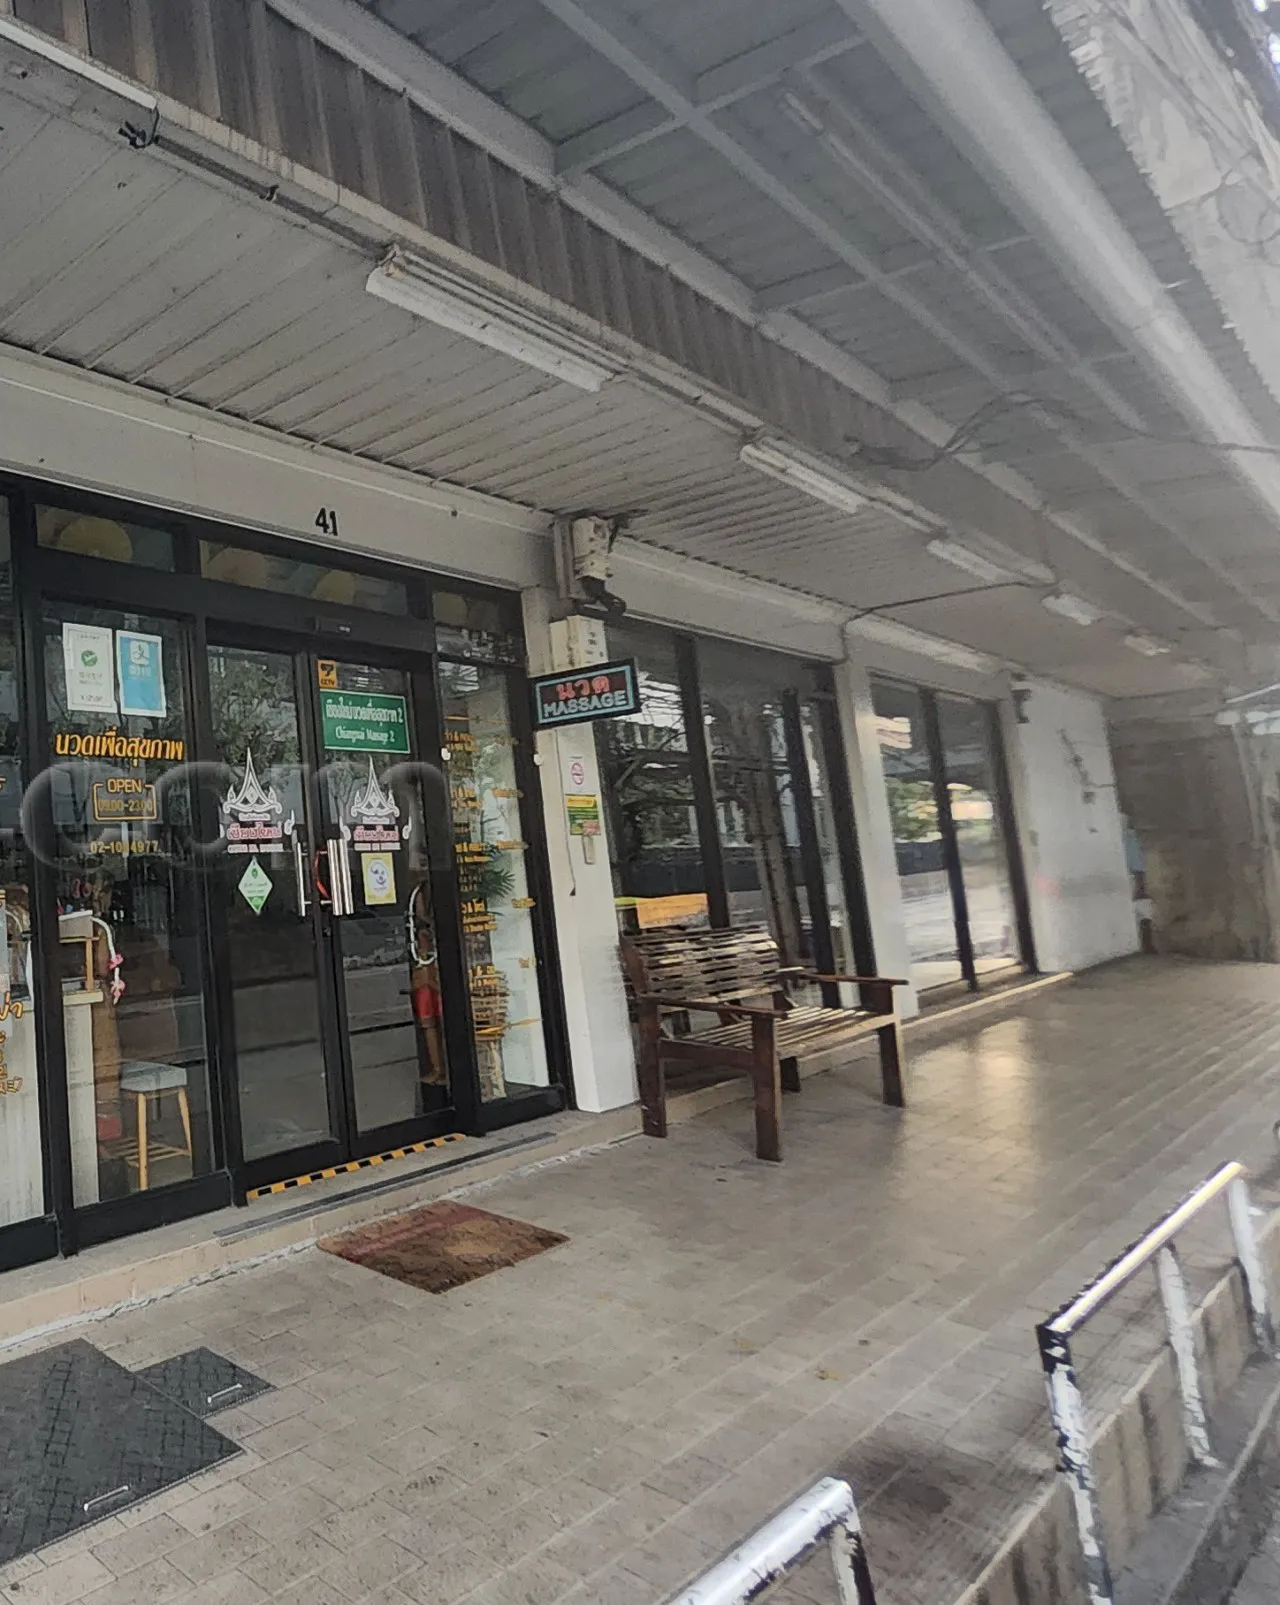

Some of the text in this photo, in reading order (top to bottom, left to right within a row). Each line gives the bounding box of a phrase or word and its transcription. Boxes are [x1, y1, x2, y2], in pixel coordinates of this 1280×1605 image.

[315, 507, 338, 536] 41
[556, 675, 610, 701] นวด
[543, 690, 627, 718] MASSAGE
[55, 725, 185, 767] นวดเพื่อสุขภาพ
[107, 778, 142, 793] OPEN
